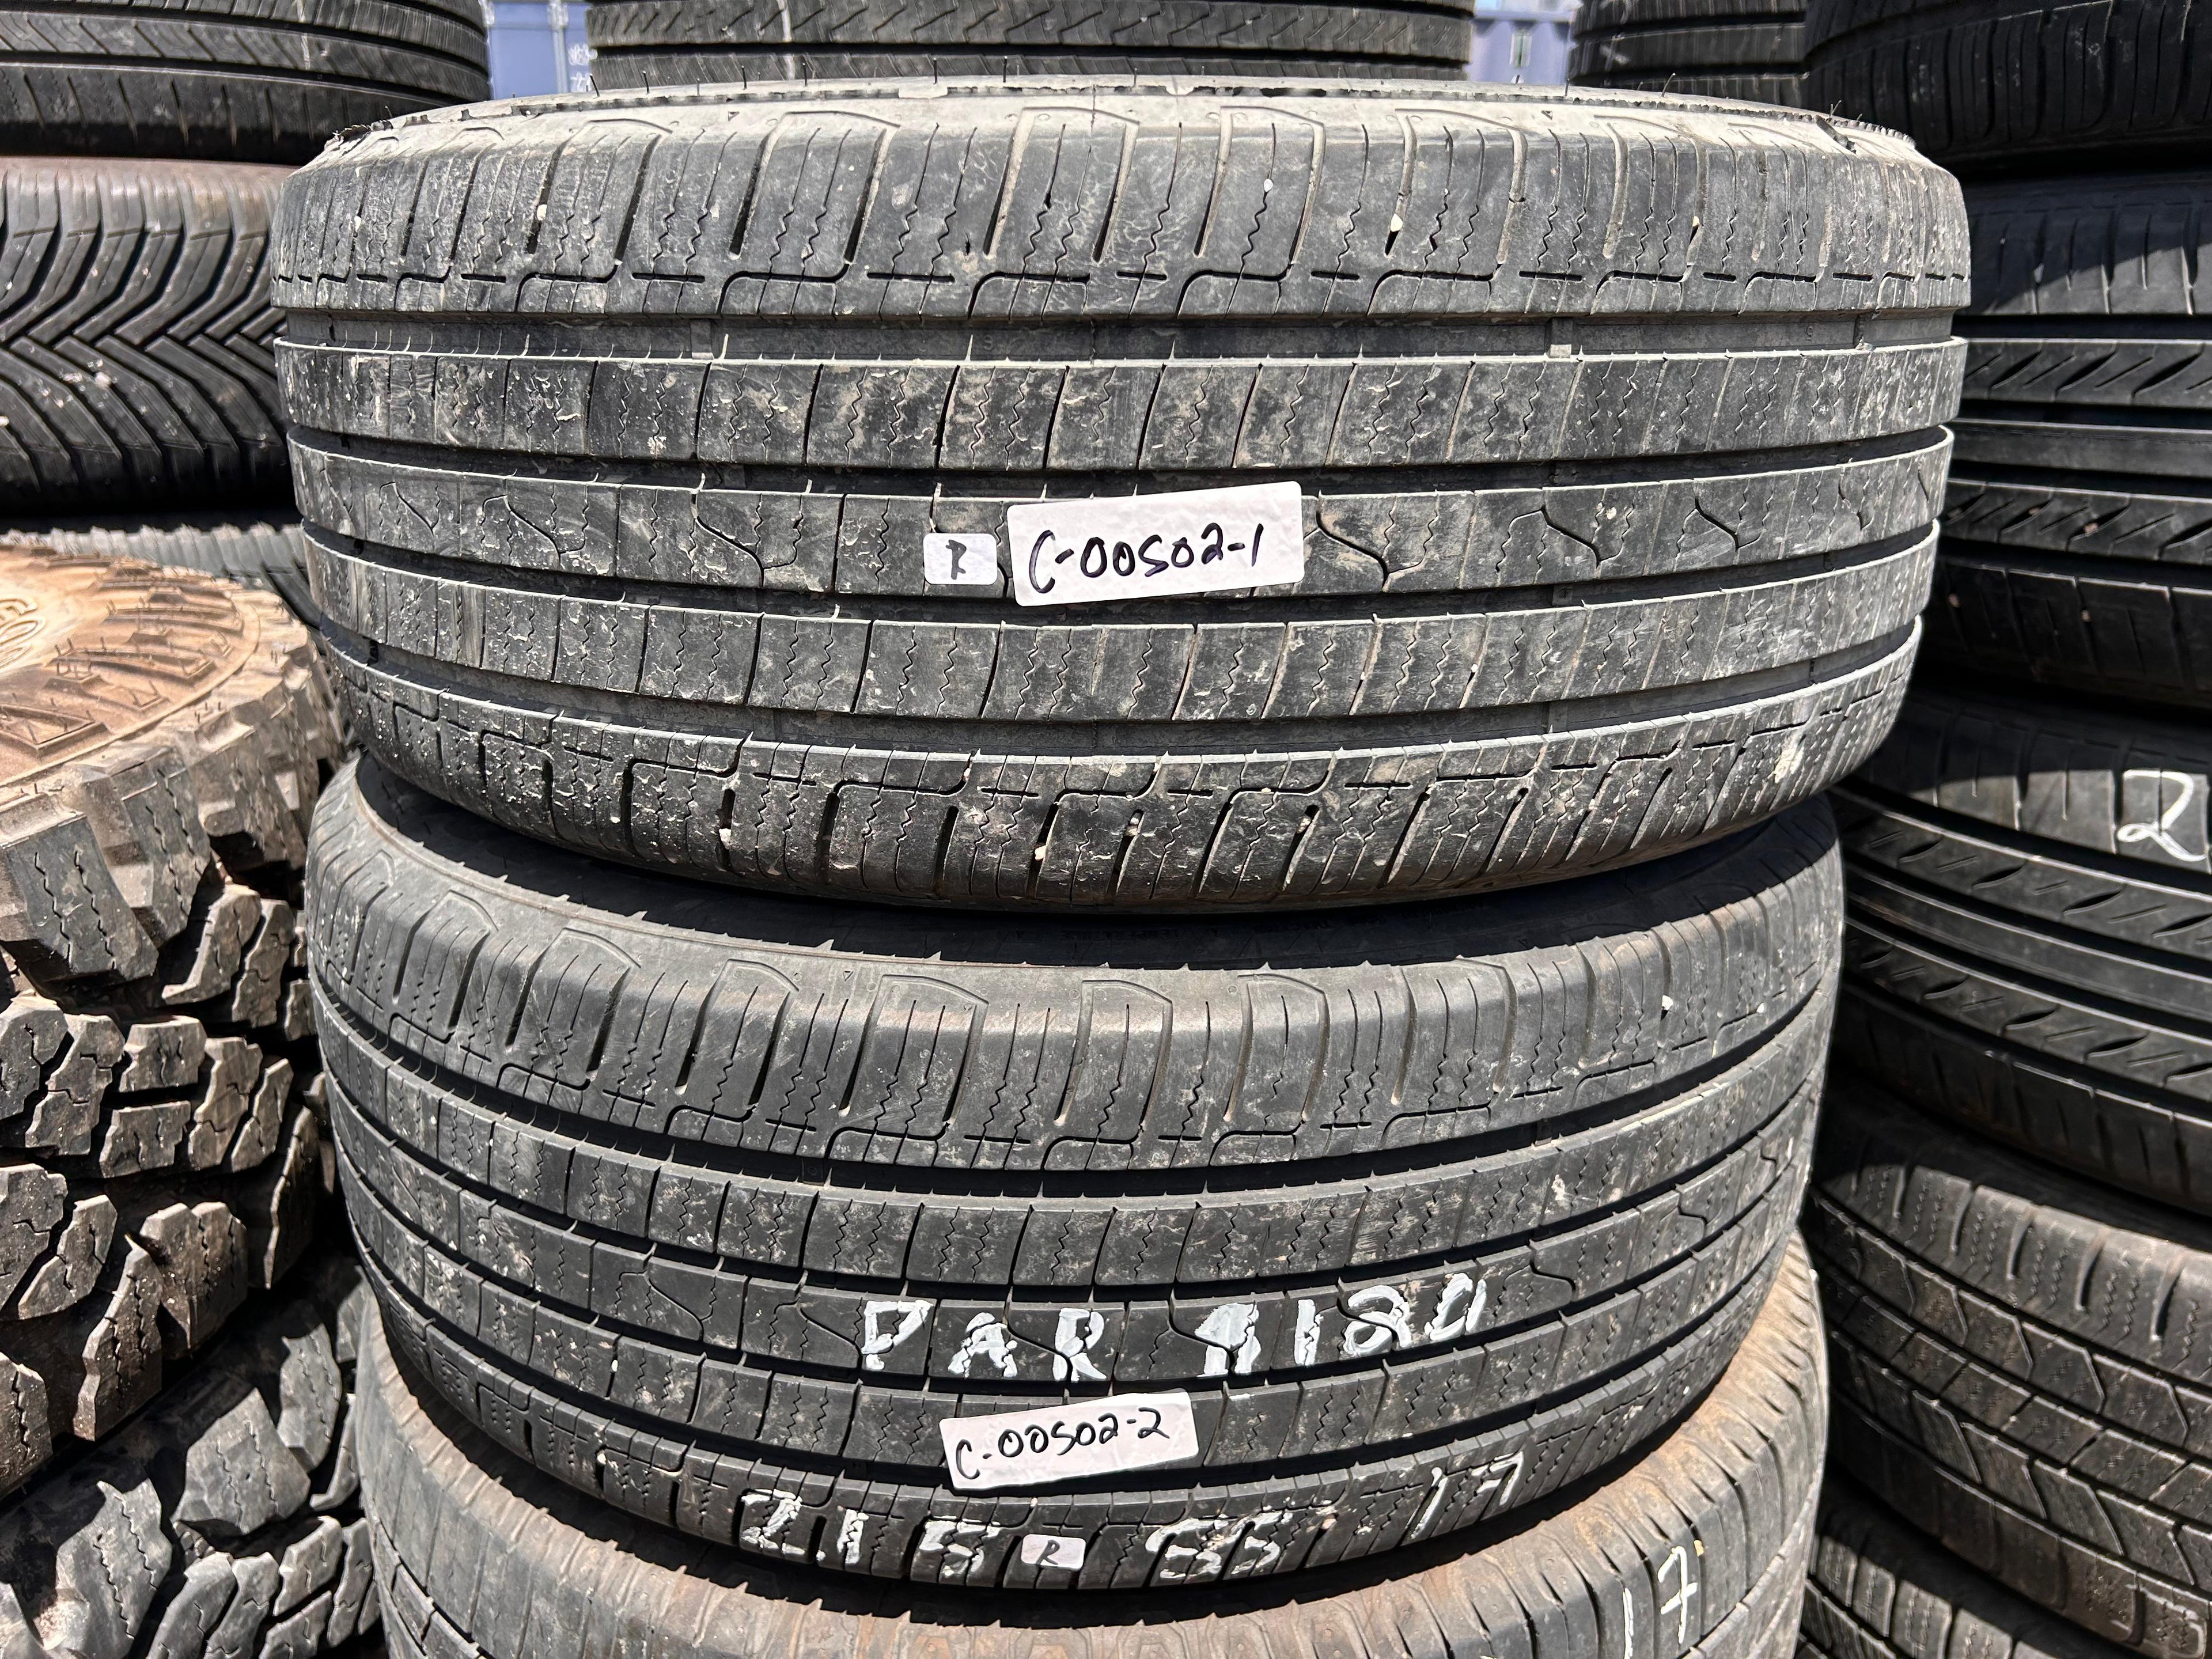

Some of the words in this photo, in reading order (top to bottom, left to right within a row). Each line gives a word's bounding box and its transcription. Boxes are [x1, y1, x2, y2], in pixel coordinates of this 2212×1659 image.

[2116, 768, 2207, 861] 2
[861, 1299, 1107, 1381] PAR
[1037, 1539, 1060, 1565] R
